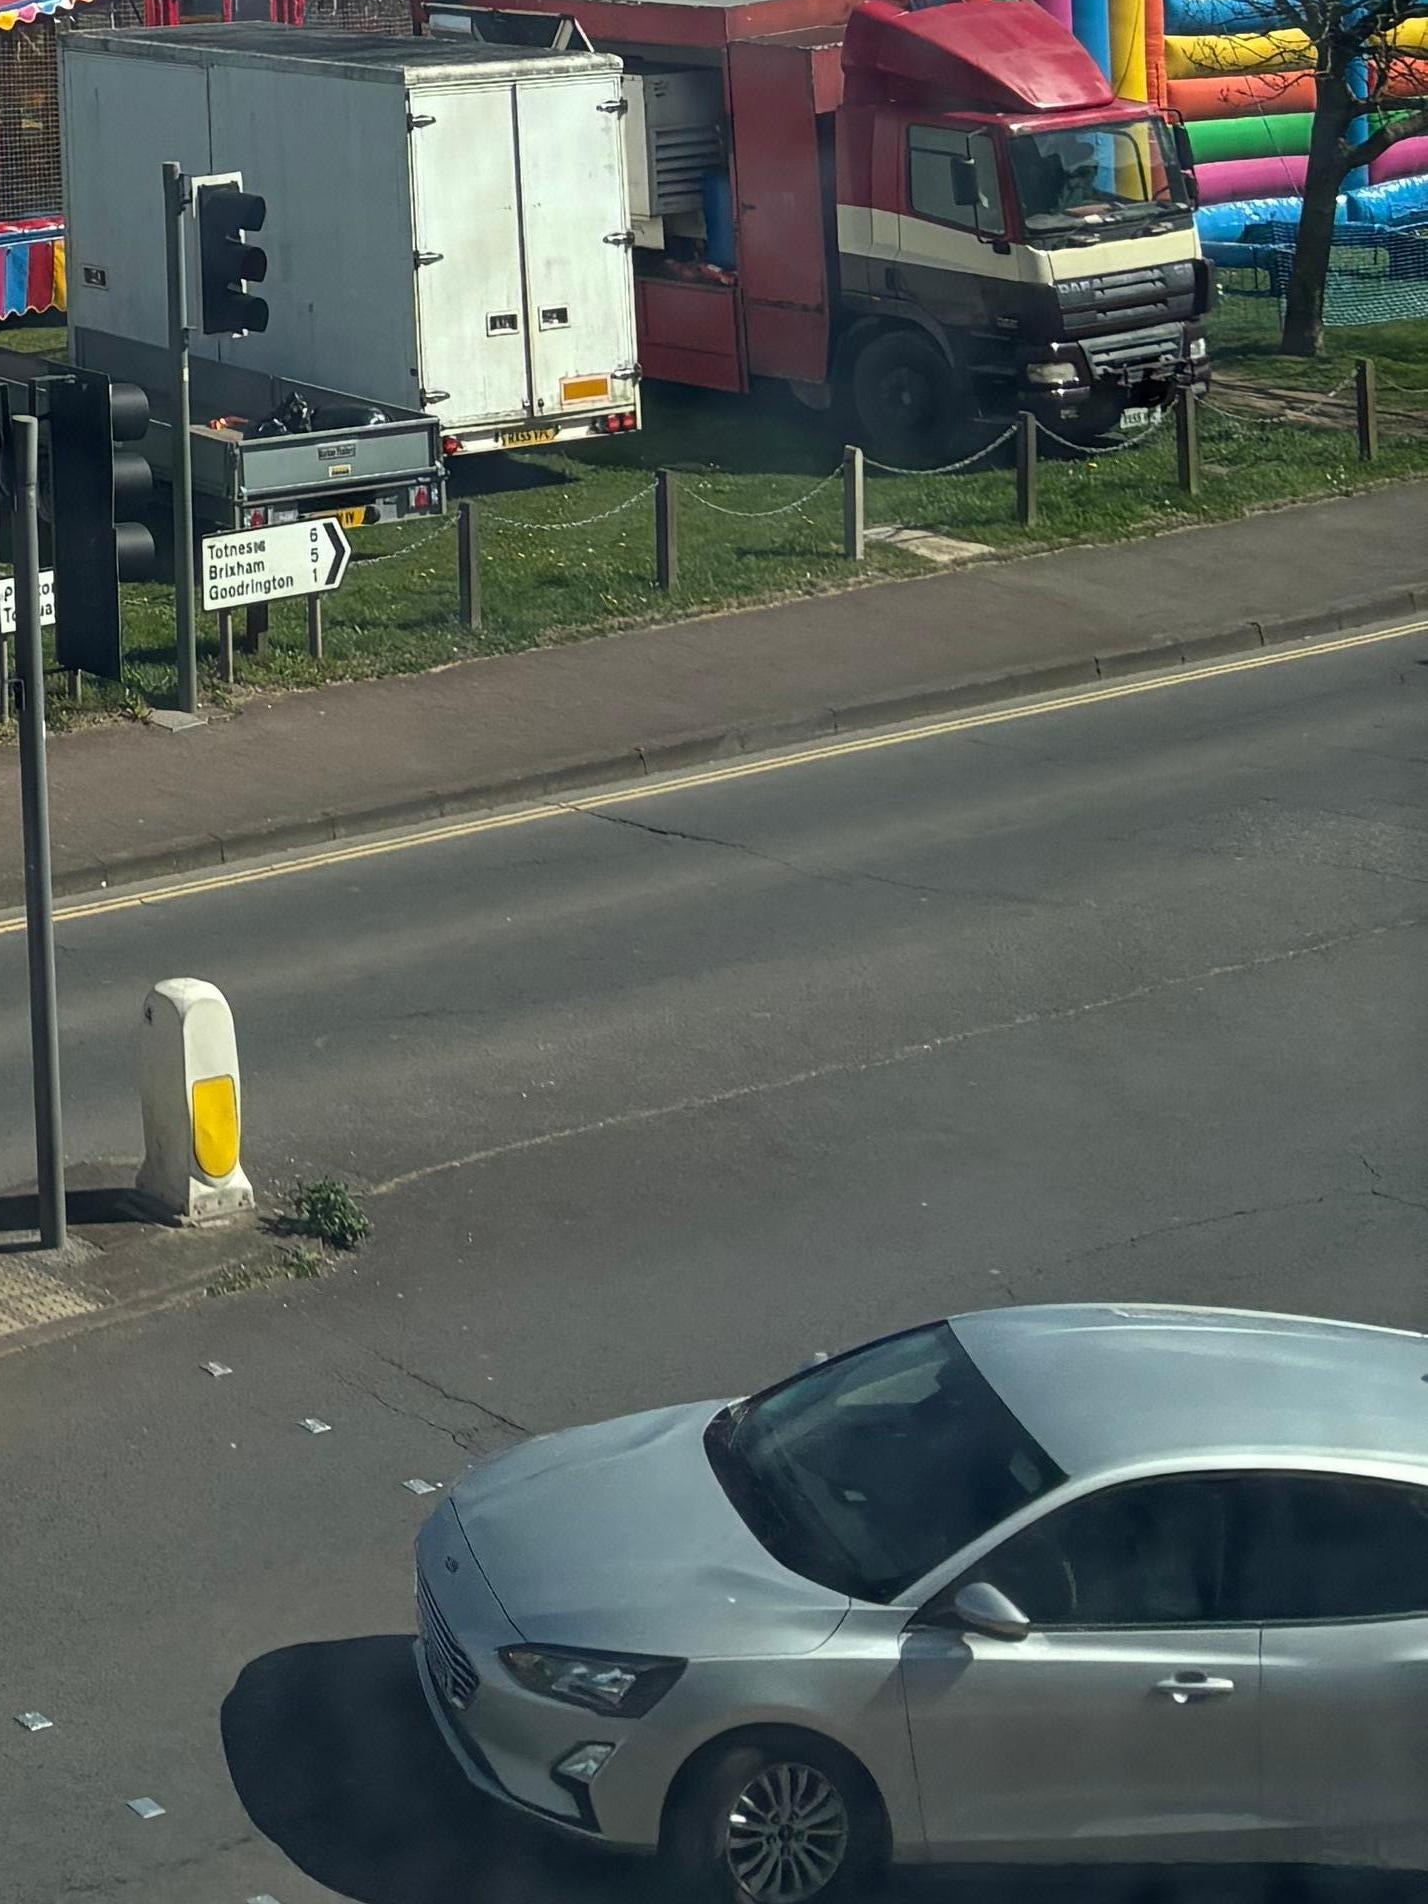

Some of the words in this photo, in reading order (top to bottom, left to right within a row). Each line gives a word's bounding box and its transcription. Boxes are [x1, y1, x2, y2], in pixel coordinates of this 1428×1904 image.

[207, 542, 252, 560] Totnes
[310, 528, 318, 542] 6
[209, 560, 265, 580] Brixham
[311, 548, 319, 562] 5
[209, 575, 293, 600] Goodrington
[312, 568, 318, 582] 1
